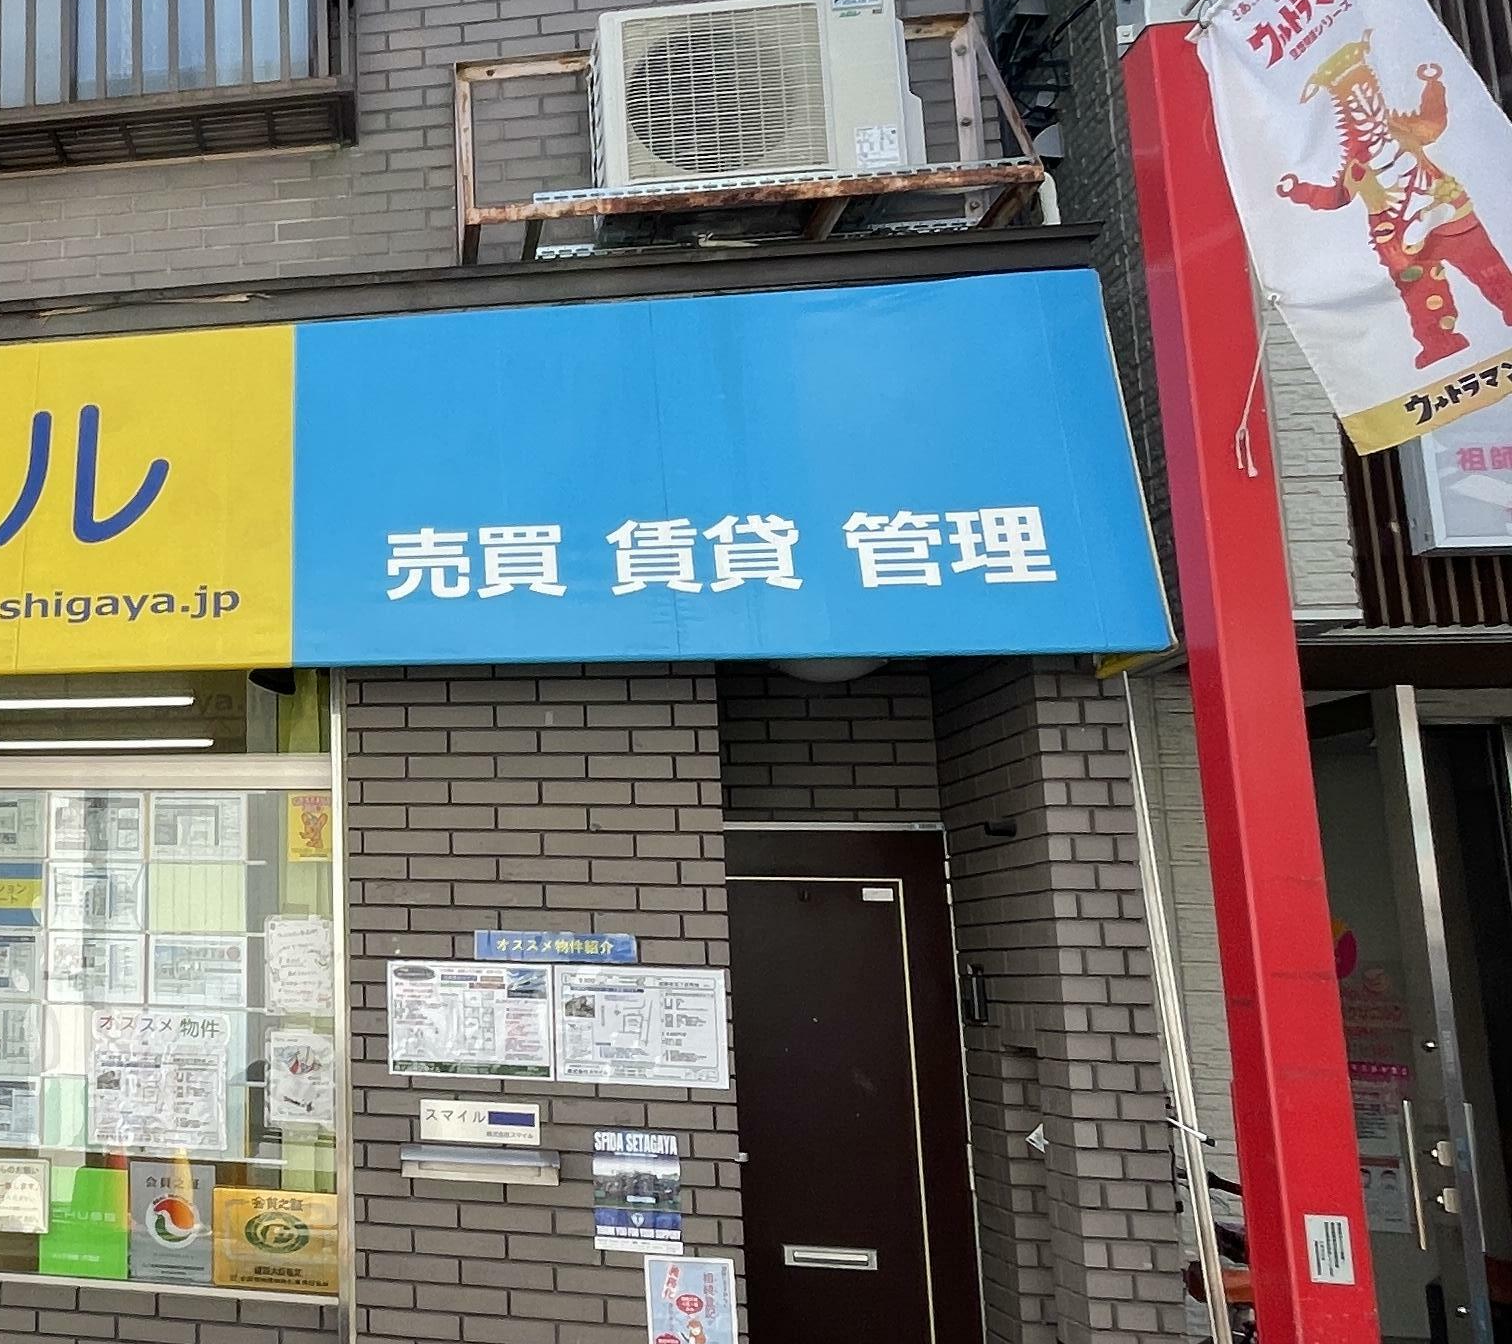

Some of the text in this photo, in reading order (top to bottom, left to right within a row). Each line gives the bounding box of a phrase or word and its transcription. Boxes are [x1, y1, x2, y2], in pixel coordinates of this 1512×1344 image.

[386, 505, 1058, 602] 売買 賃貸 管理
[99, 1015, 221, 1039] オススメ物件
[425, 1108, 487, 1124] スマイル
[625, 1132, 678, 1156] SETAGAYA
